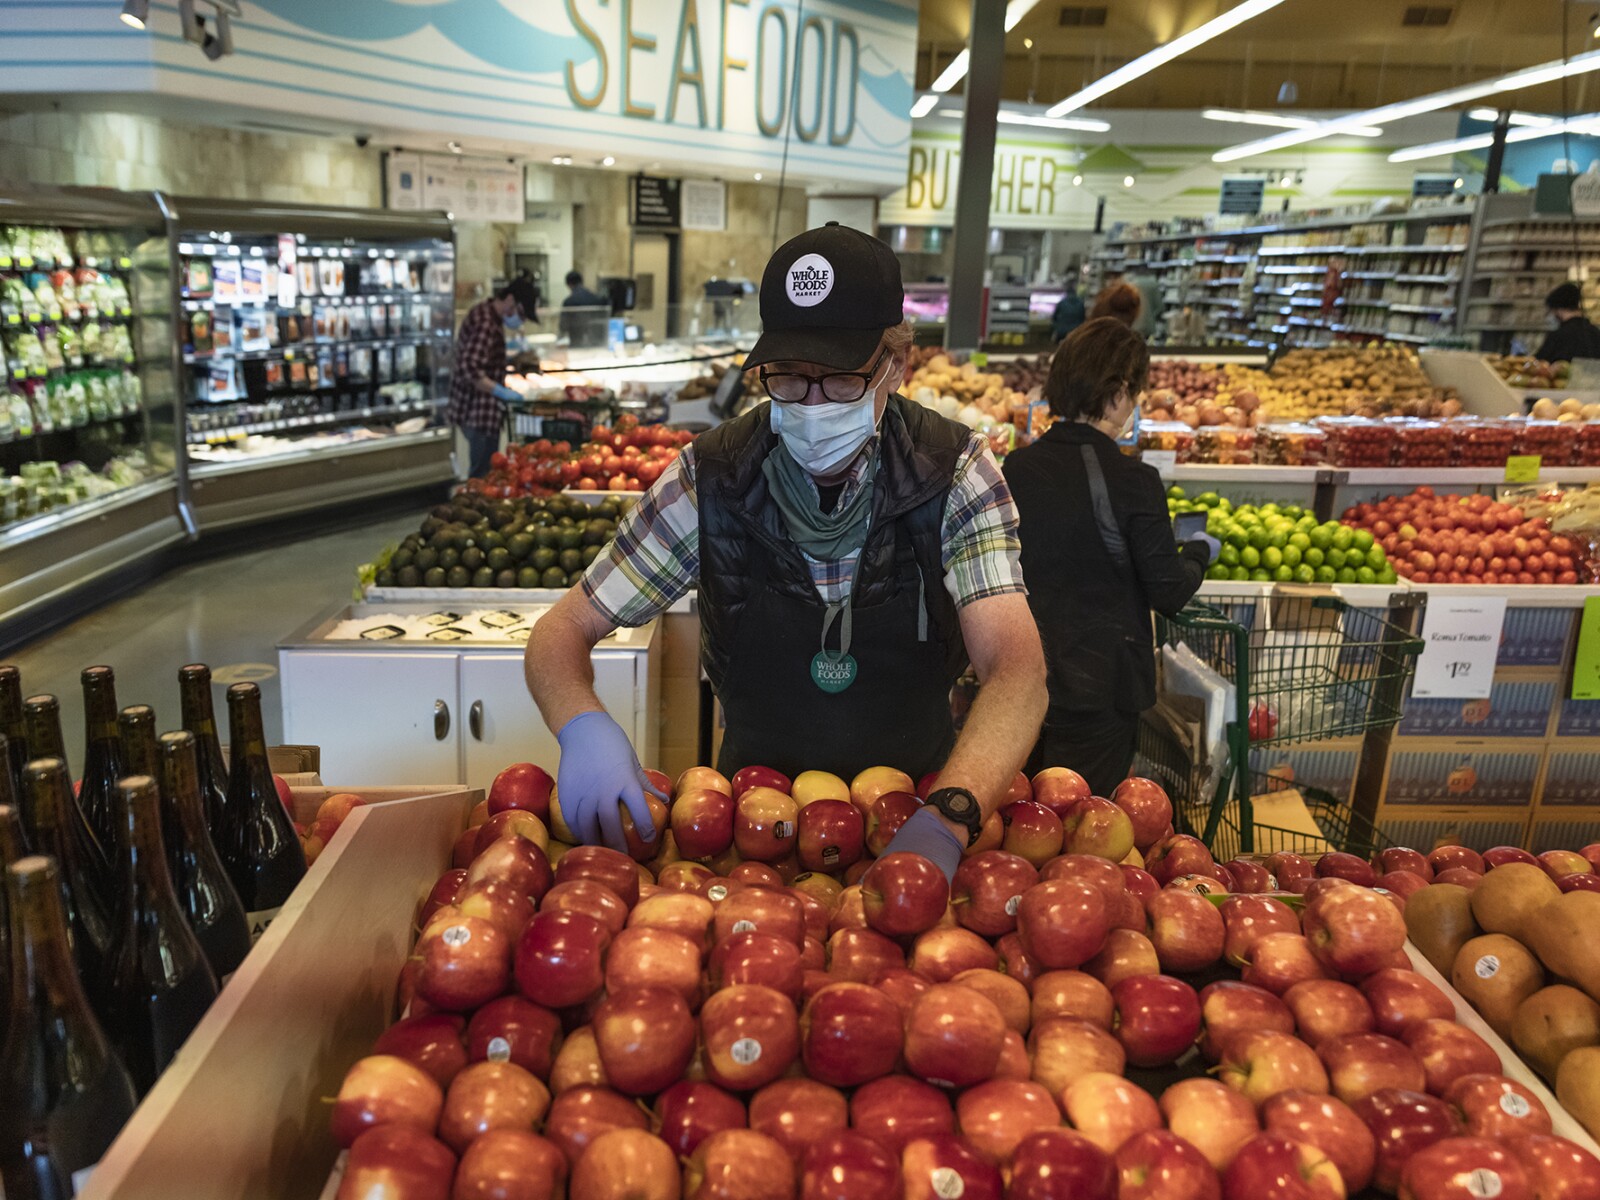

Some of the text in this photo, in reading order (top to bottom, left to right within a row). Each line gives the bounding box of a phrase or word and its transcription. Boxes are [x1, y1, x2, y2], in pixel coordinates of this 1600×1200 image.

[563, 0, 860, 147] SEAFOOD
[906, 147, 1057, 215] BUHER
[791, 270, 829, 281] WHOLE
[792, 280, 828, 291] FOODS
[1431, 632, 1492, 641] Roma Tomato
[816, 660, 852, 671] WHOLE
[817, 670, 851, 680] FOODS
